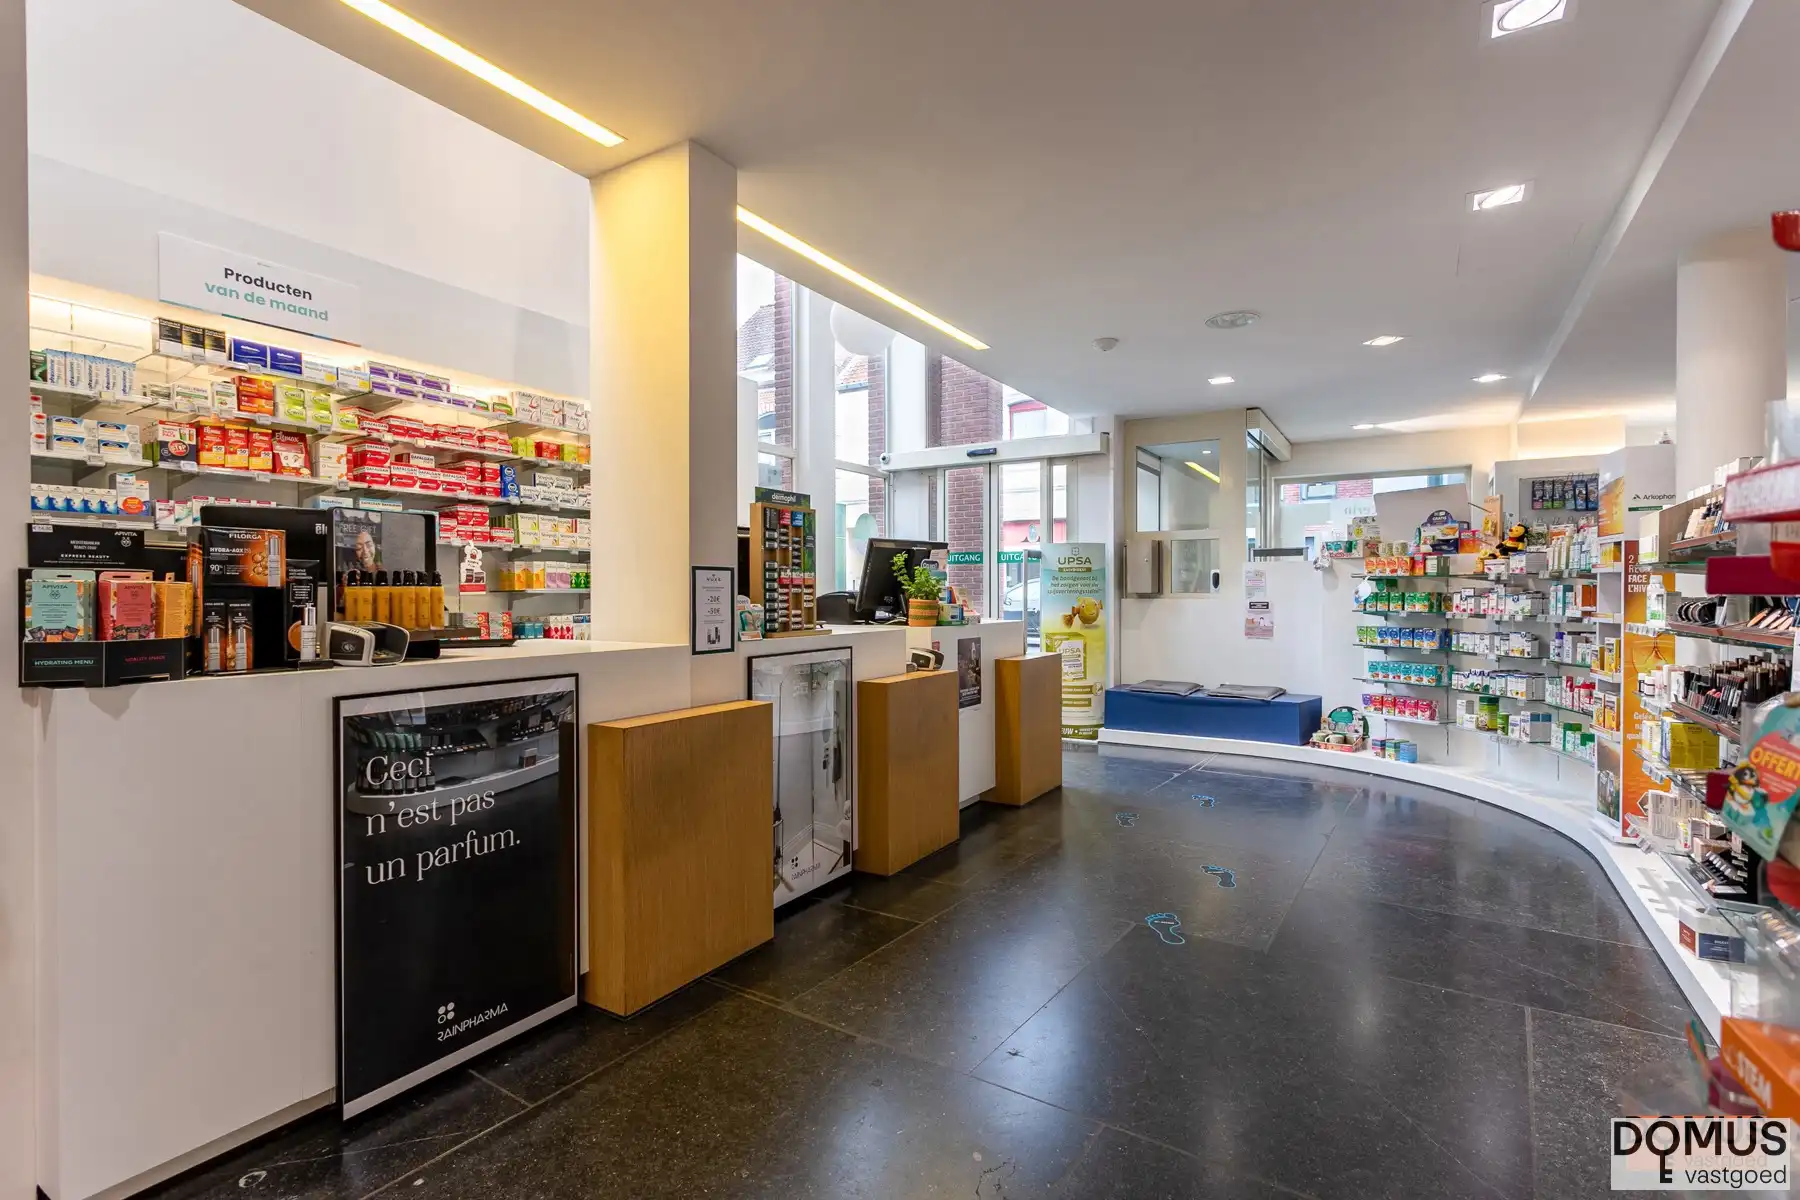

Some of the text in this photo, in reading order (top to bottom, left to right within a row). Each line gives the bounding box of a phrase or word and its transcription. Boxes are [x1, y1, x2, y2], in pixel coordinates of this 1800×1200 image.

[224, 267, 312, 300] Producten
[205, 282, 329, 321] van de maand
[771, 493, 797, 503] dermophil
[339, 523, 357, 533] FREE
[1058, 556, 1092, 565] UPSA
[1628, 555, 1634, 564] 2
[1628, 574, 1647, 583] FACE
[1628, 584, 1647, 593] L'HIV
[366, 755, 433, 785] Ceci
[365, 789, 495, 836] n'est pas
[365, 828, 521, 885] un parfum.
[437, 1002, 508, 1042] RAINPHARMA
